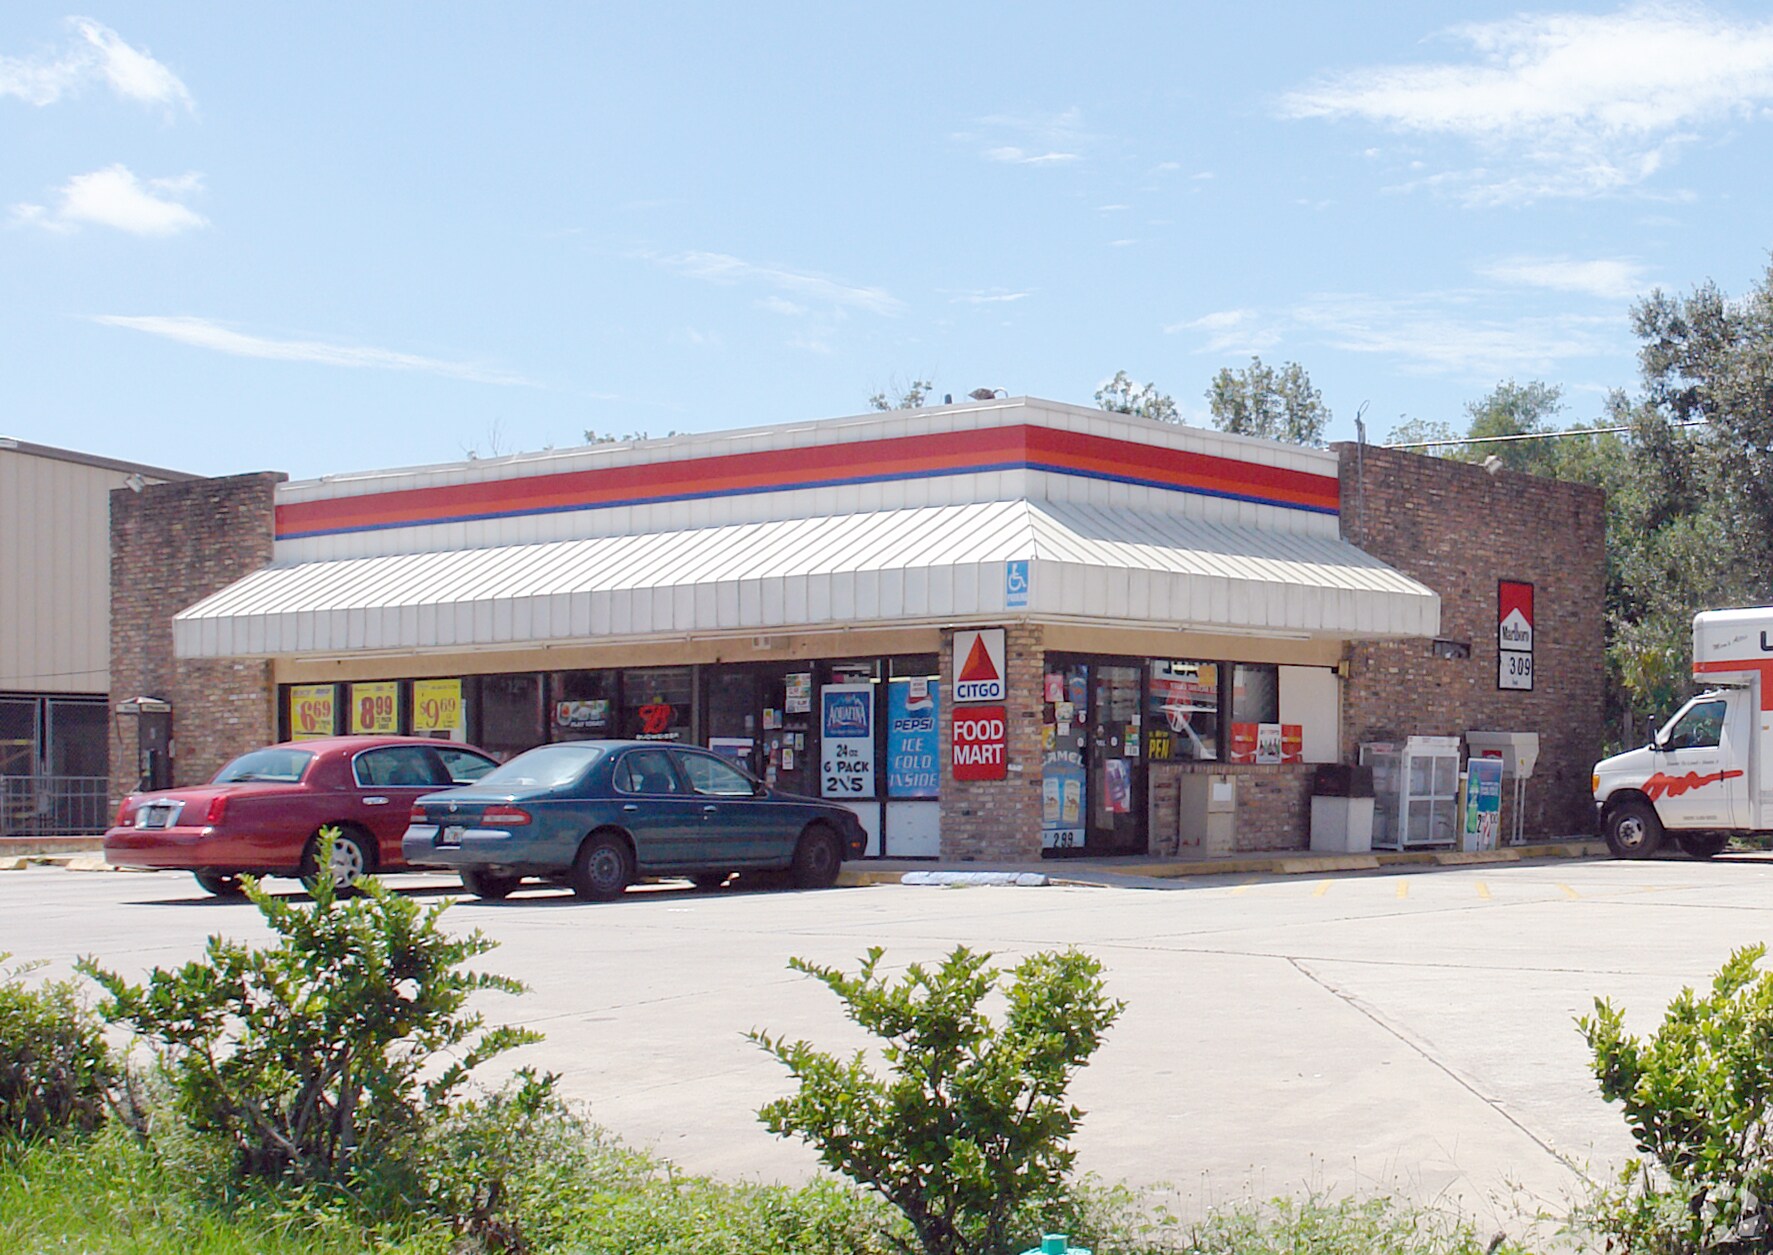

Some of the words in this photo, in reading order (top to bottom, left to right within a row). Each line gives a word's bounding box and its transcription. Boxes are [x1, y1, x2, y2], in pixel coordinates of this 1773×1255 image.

[957, 683, 1000, 698] CITGO
[894, 718, 934, 731] PEPSI
[953, 719, 1004, 741] FOOD
[902, 738, 925, 752] ICE
[1148, 739, 1169, 760] PEN
[953, 744, 1004, 765] MART
[836, 761, 870, 773] PACK
[894, 755, 932, 769] COLD
